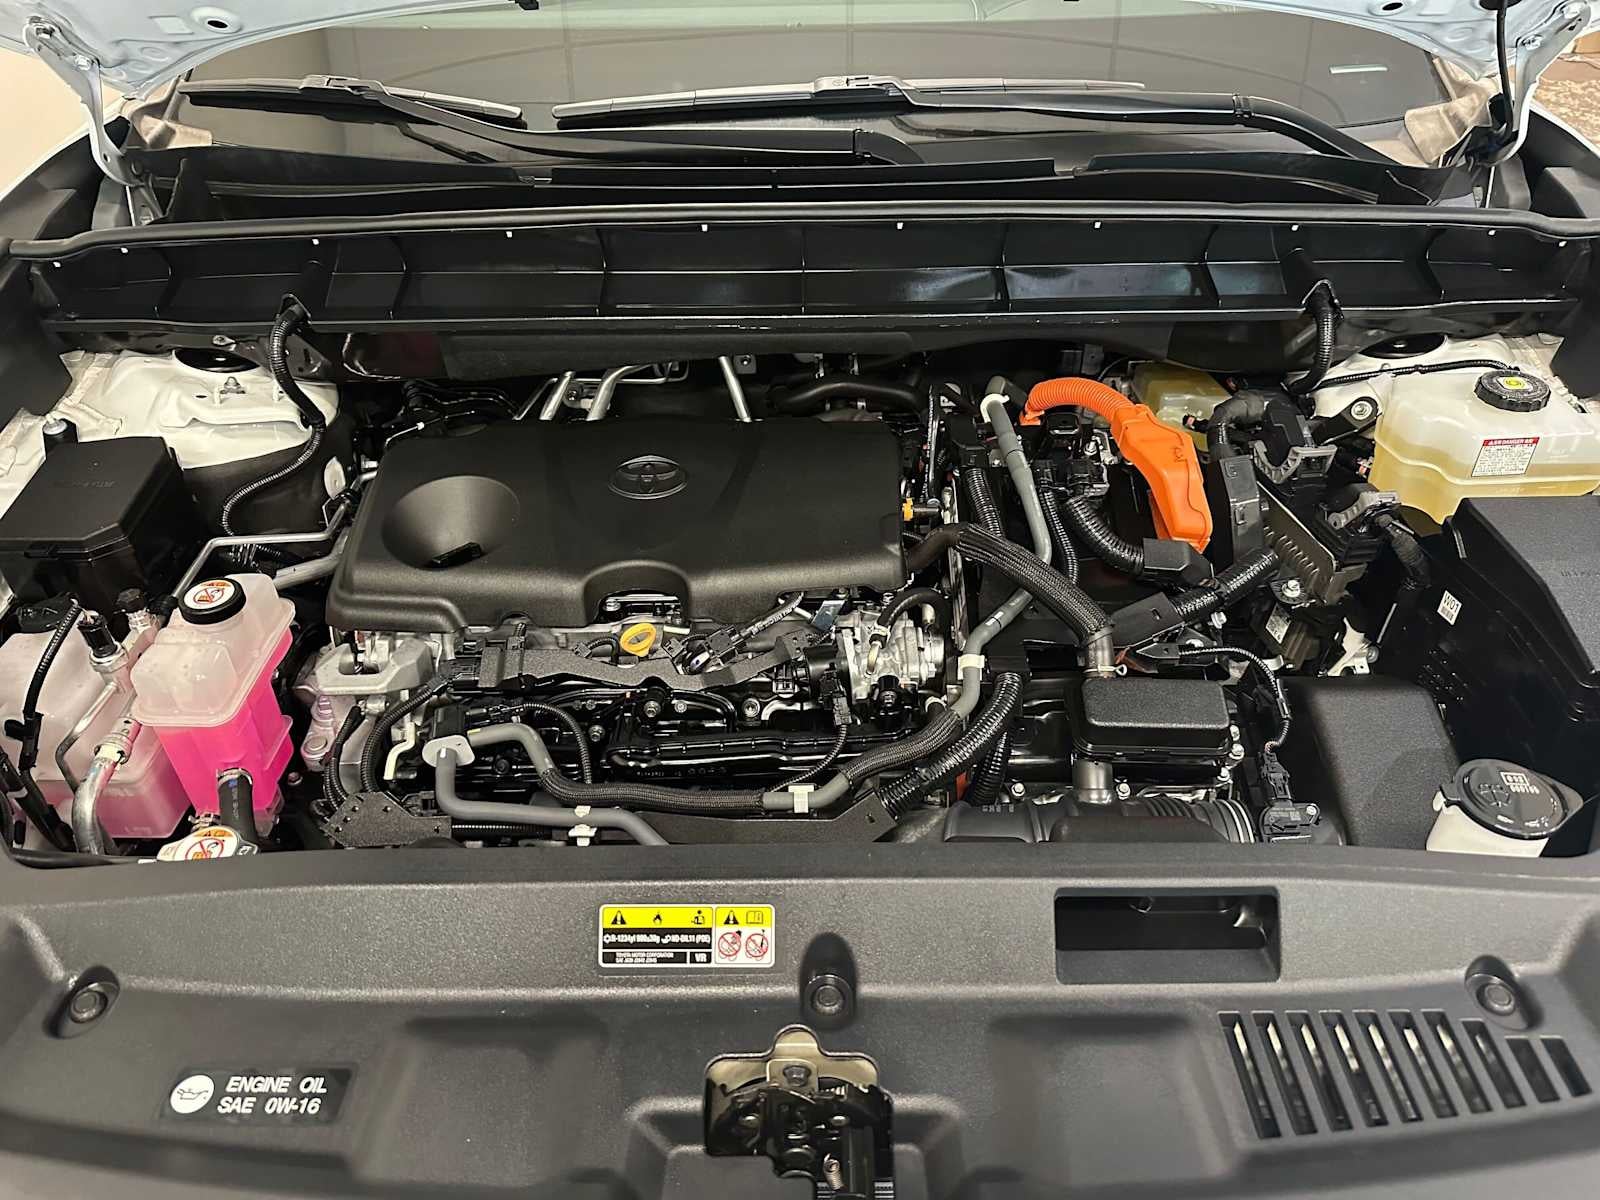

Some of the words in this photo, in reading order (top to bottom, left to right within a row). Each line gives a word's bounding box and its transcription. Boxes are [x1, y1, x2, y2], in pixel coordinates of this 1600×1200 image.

[694, 953, 707, 963] VR
[225, 1076, 292, 1094] ENGINE
[299, 1076, 328, 1094] OIL
[217, 1096, 257, 1114] SAE
[264, 1098, 322, 1115] 0W-16
